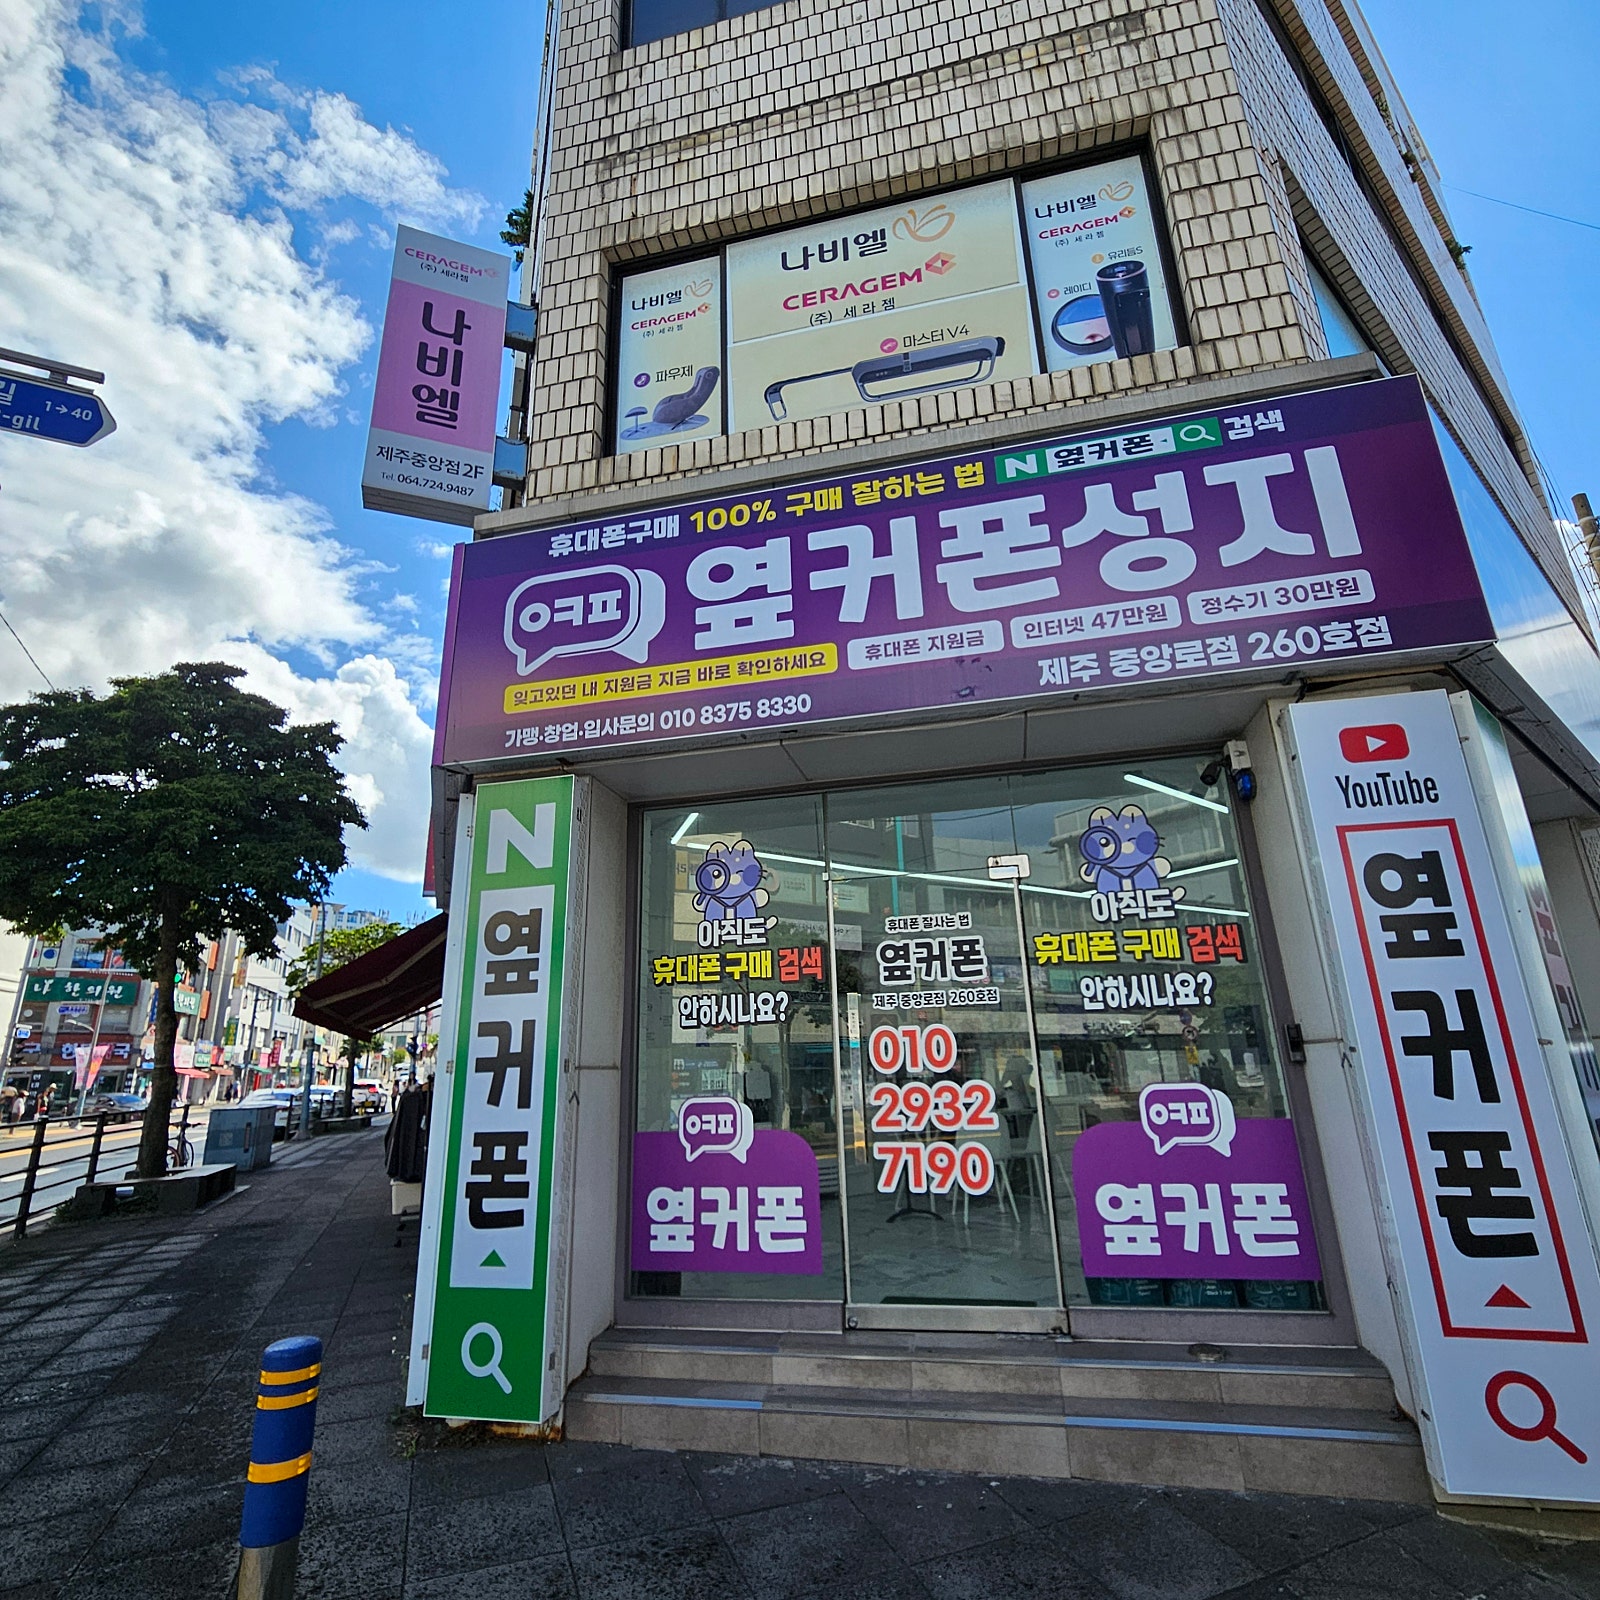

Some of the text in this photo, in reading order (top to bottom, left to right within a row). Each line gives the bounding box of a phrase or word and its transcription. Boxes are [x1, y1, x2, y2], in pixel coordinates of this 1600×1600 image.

[1034, 194, 1098, 219] 나비엘
[1038, 214, 1119, 240] CERAGEM
[1054, 238, 1069, 248] (주)
[404, 247, 484, 276] CERAGEM
[780, 227, 888, 271] 나비엘
[420, 261, 470, 283] (주) 세라젬
[782, 267, 923, 311] CERAGEM
[1063, 281, 1092, 295] 레이디
[631, 289, 682, 311] 나비엘
[809, 309, 833, 327] (주)
[631, 309, 697, 331] CERAGEM
[903, 329, 945, 348] 마스터
[947, 324, 970, 338] V4
[411, 301, 472, 430] 나비엘
[655, 364, 693, 383] 파우제
[71, 407, 93, 421] 40
[376, 444, 485, 480] 제주중앙점 2F
[397, 472, 475, 497] 064.724.9487
[548, 409, 1286, 558] 휴대폰구매 100% 구매 잘하는 법 N 옆커폰 검색
[686, 444, 1363, 651] 옆커폰성지
[1200, 577, 1361, 617] 정수기 30만원
[1023, 602, 1168, 640] 인터넷 47만원
[864, 629, 985, 661] 휴대폰 지원금
[1037, 615, 1393, 687] 제주 중앙로점 260호점
[582, 680, 598, 698] 내
[603, 673, 652, 695] 지원금
[658, 668, 691, 688] 지금
[697, 664, 731, 682] 바로
[737, 651, 826, 677] 확인하세요
[659, 708, 696, 730] 010
[700, 701, 752, 725] 8375
[756, 693, 812, 719] 8330
[1334, 770, 1440, 809] YouTube
[485, 802, 556, 875] N
[887, 913, 970, 932] 휴대폰 잘사는 법
[1090, 888, 1176, 922] 아직도
[698, 917, 767, 947] 아직도
[1034, 924, 1244, 964] 휴대폰 구매 검색
[653, 946, 823, 985] 휴대폰 구매 검색
[879, 938, 984, 982] 옆커폰
[679, 990, 789, 1028] 안하시나요?
[874, 988, 998, 1008] 제주 중앙로점 260호점
[1080, 972, 1213, 1011] 안하시나요?
[871, 1026, 955, 1072] 010
[1362, 849, 1542, 1260] 옆커폰
[464, 907, 544, 1230] 옆커폰
[872, 1083, 997, 1129] 2932
[875, 1144, 991, 1192] 7190
[646, 1186, 808, 1254] 옆커폰
[1095, 1183, 1300, 1257] 옆커폰
